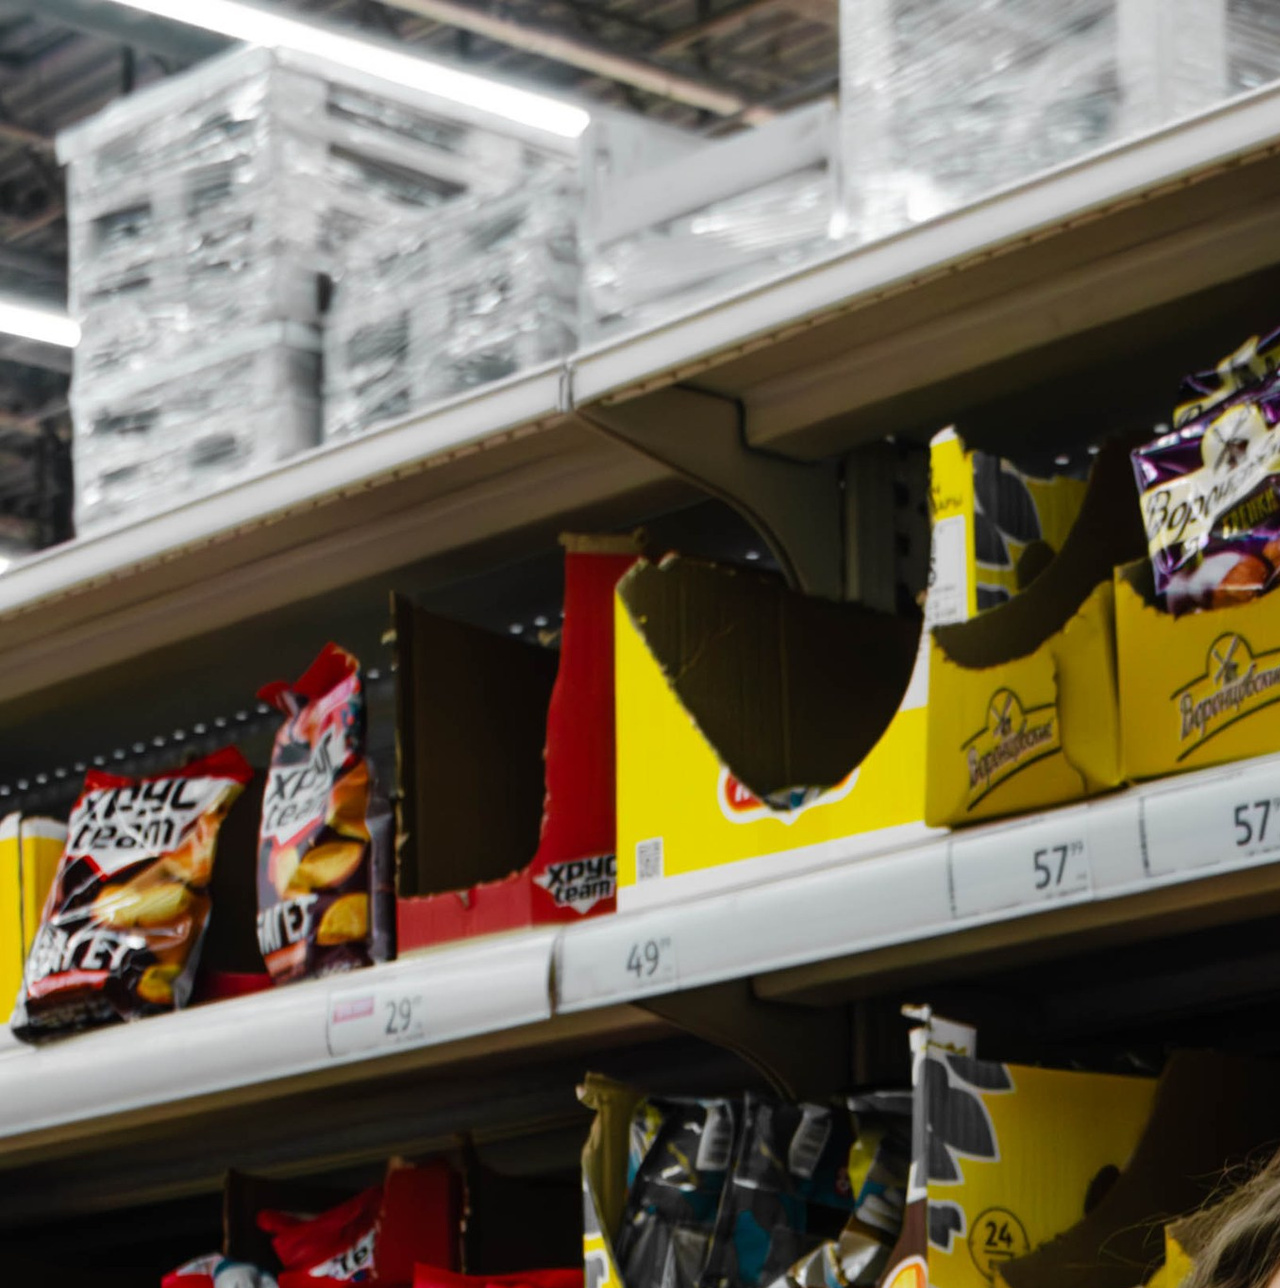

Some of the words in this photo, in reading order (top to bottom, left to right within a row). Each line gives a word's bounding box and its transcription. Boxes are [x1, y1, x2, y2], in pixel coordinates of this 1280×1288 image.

[1233, 799, 1271, 847] 57
[1033, 845, 1069, 890] 57
[626, 941, 660, 978] 49
[385, 996, 411, 1036] 29
[985, 1221, 1014, 1247] 24
